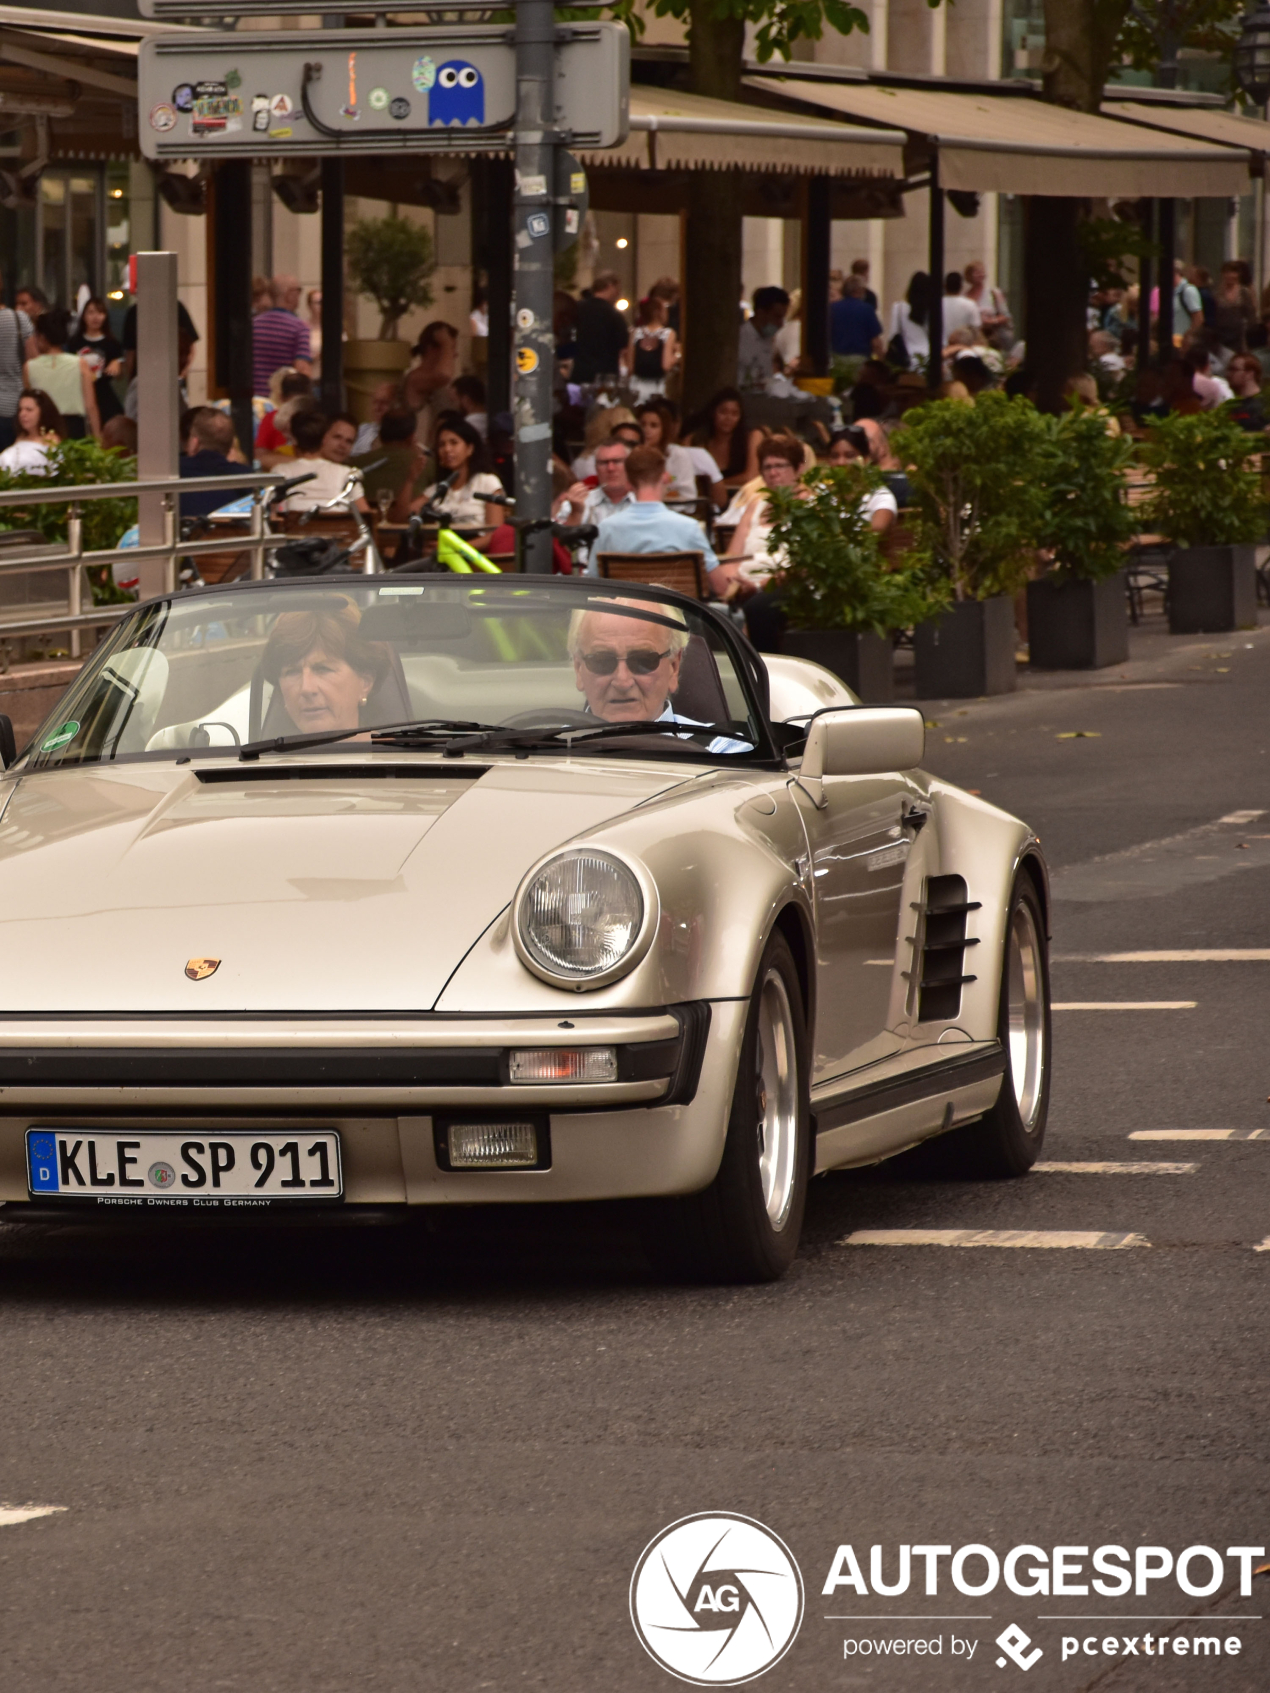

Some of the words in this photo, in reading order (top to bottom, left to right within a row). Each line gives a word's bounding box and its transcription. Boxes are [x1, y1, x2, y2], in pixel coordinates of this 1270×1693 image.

[39, 1168, 50, 1181] D
[59, 1140, 145, 1187] KLE
[181, 1142, 235, 1188] SP
[250, 1142, 335, 1188] 911
